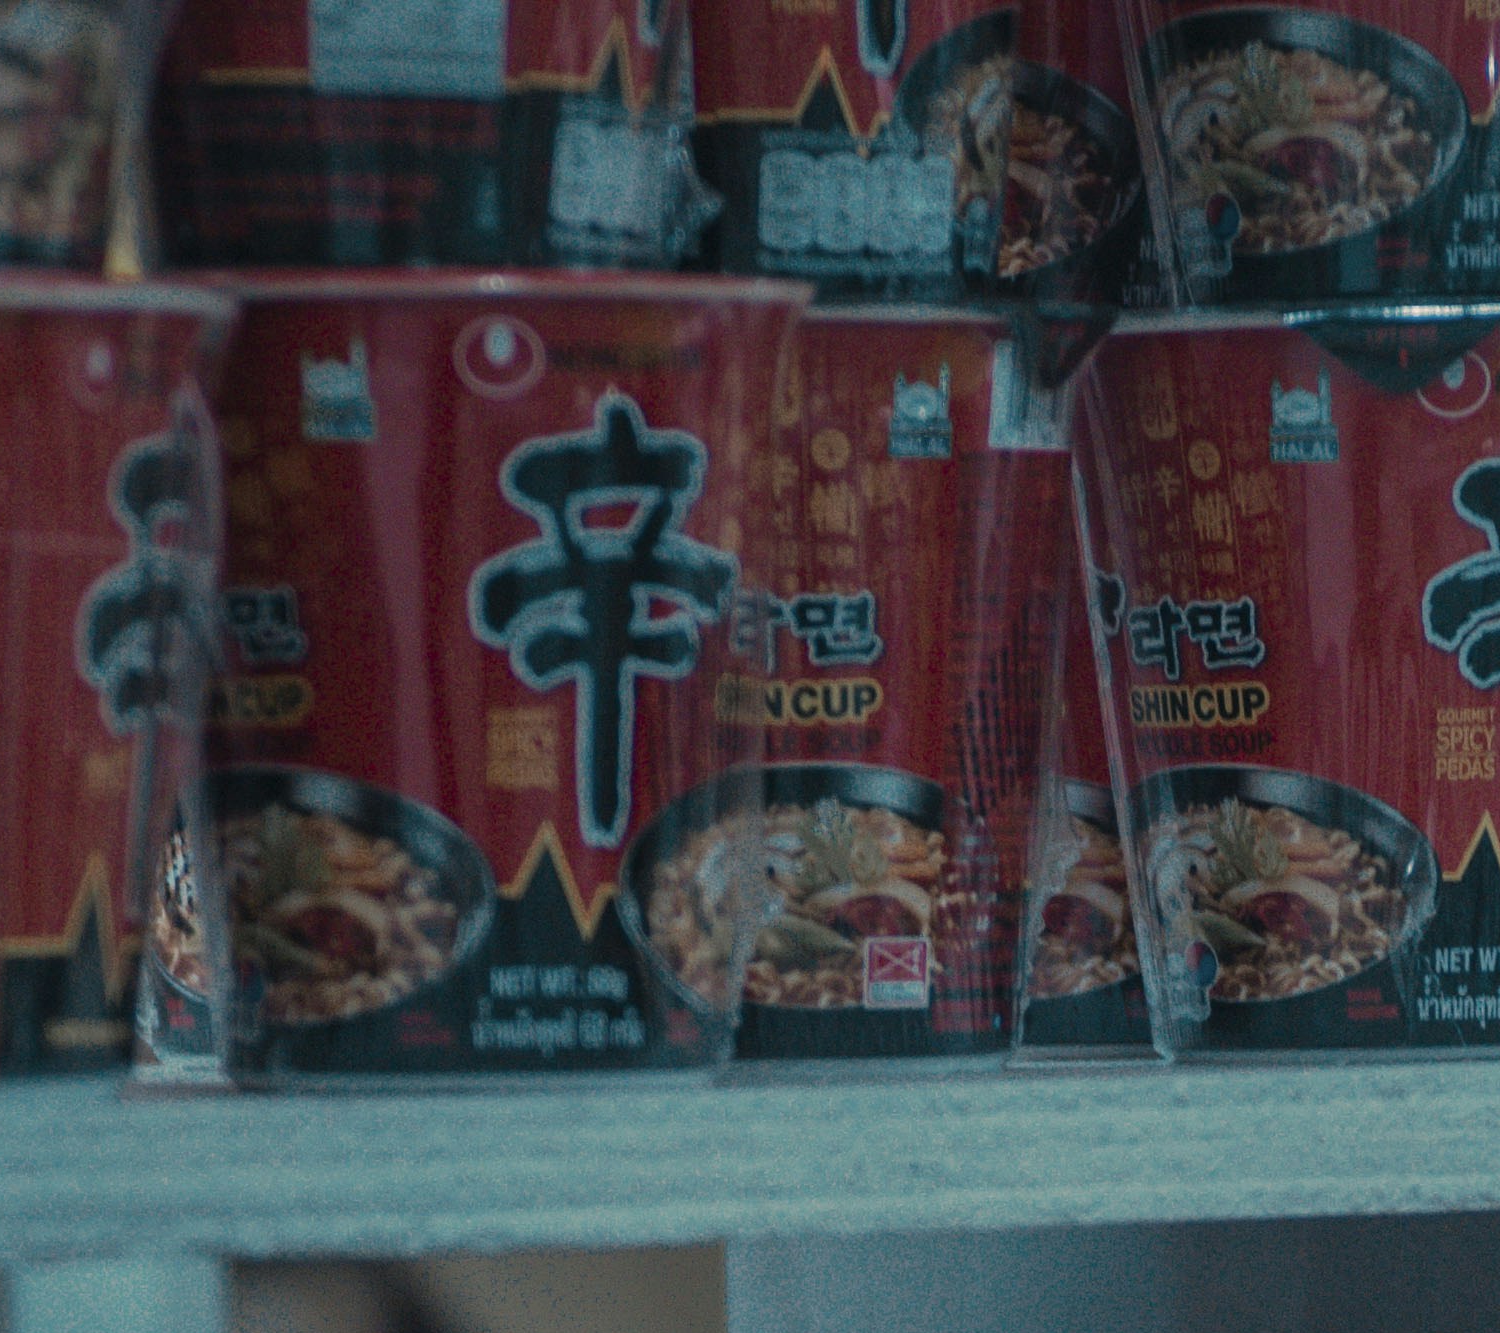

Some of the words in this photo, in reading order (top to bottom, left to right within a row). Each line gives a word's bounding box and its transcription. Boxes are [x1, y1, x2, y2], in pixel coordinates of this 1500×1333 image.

[1464, 193, 1500, 221] NET
[1270, 440, 1338, 461] HALAL
[468, 388, 739, 845] 辛
[1129, 596, 1266, 680] 라면
[793, 682, 880, 719] CUP
[1130, 689, 1190, 724] SHIN
[1193, 688, 1268, 721] CUP
[1208, 730, 1274, 754] SOUP
[1435, 726, 1497, 751] SPICY
[1435, 756, 1497, 781] PEDAS
[1434, 946, 1472, 974] NET
